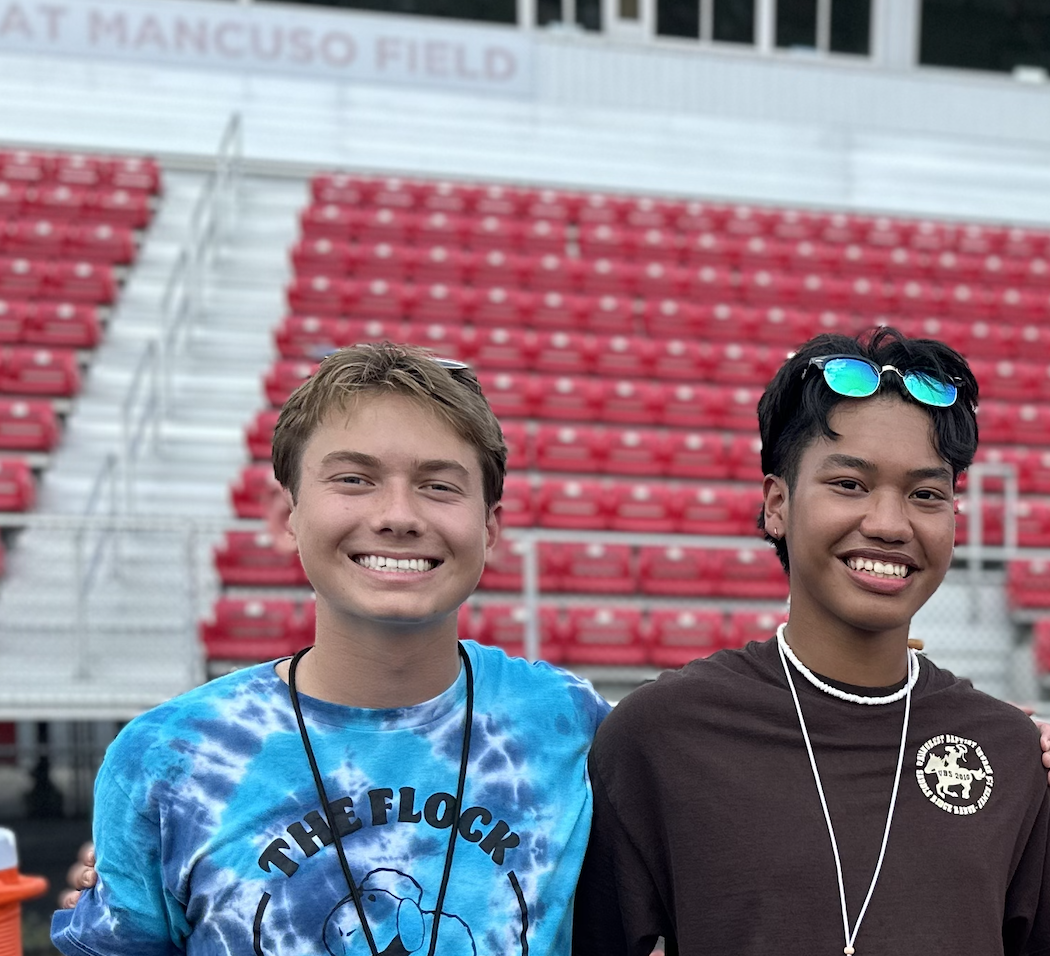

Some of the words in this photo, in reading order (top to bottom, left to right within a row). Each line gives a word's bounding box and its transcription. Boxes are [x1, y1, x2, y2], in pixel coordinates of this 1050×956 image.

[0, 6, 70, 43] AT
[88, 11, 358, 69] MANCUSO
[375, 37, 519, 82] FIELD
[258, 796, 363, 878] THE
[367, 787, 521, 866] FLOCK
